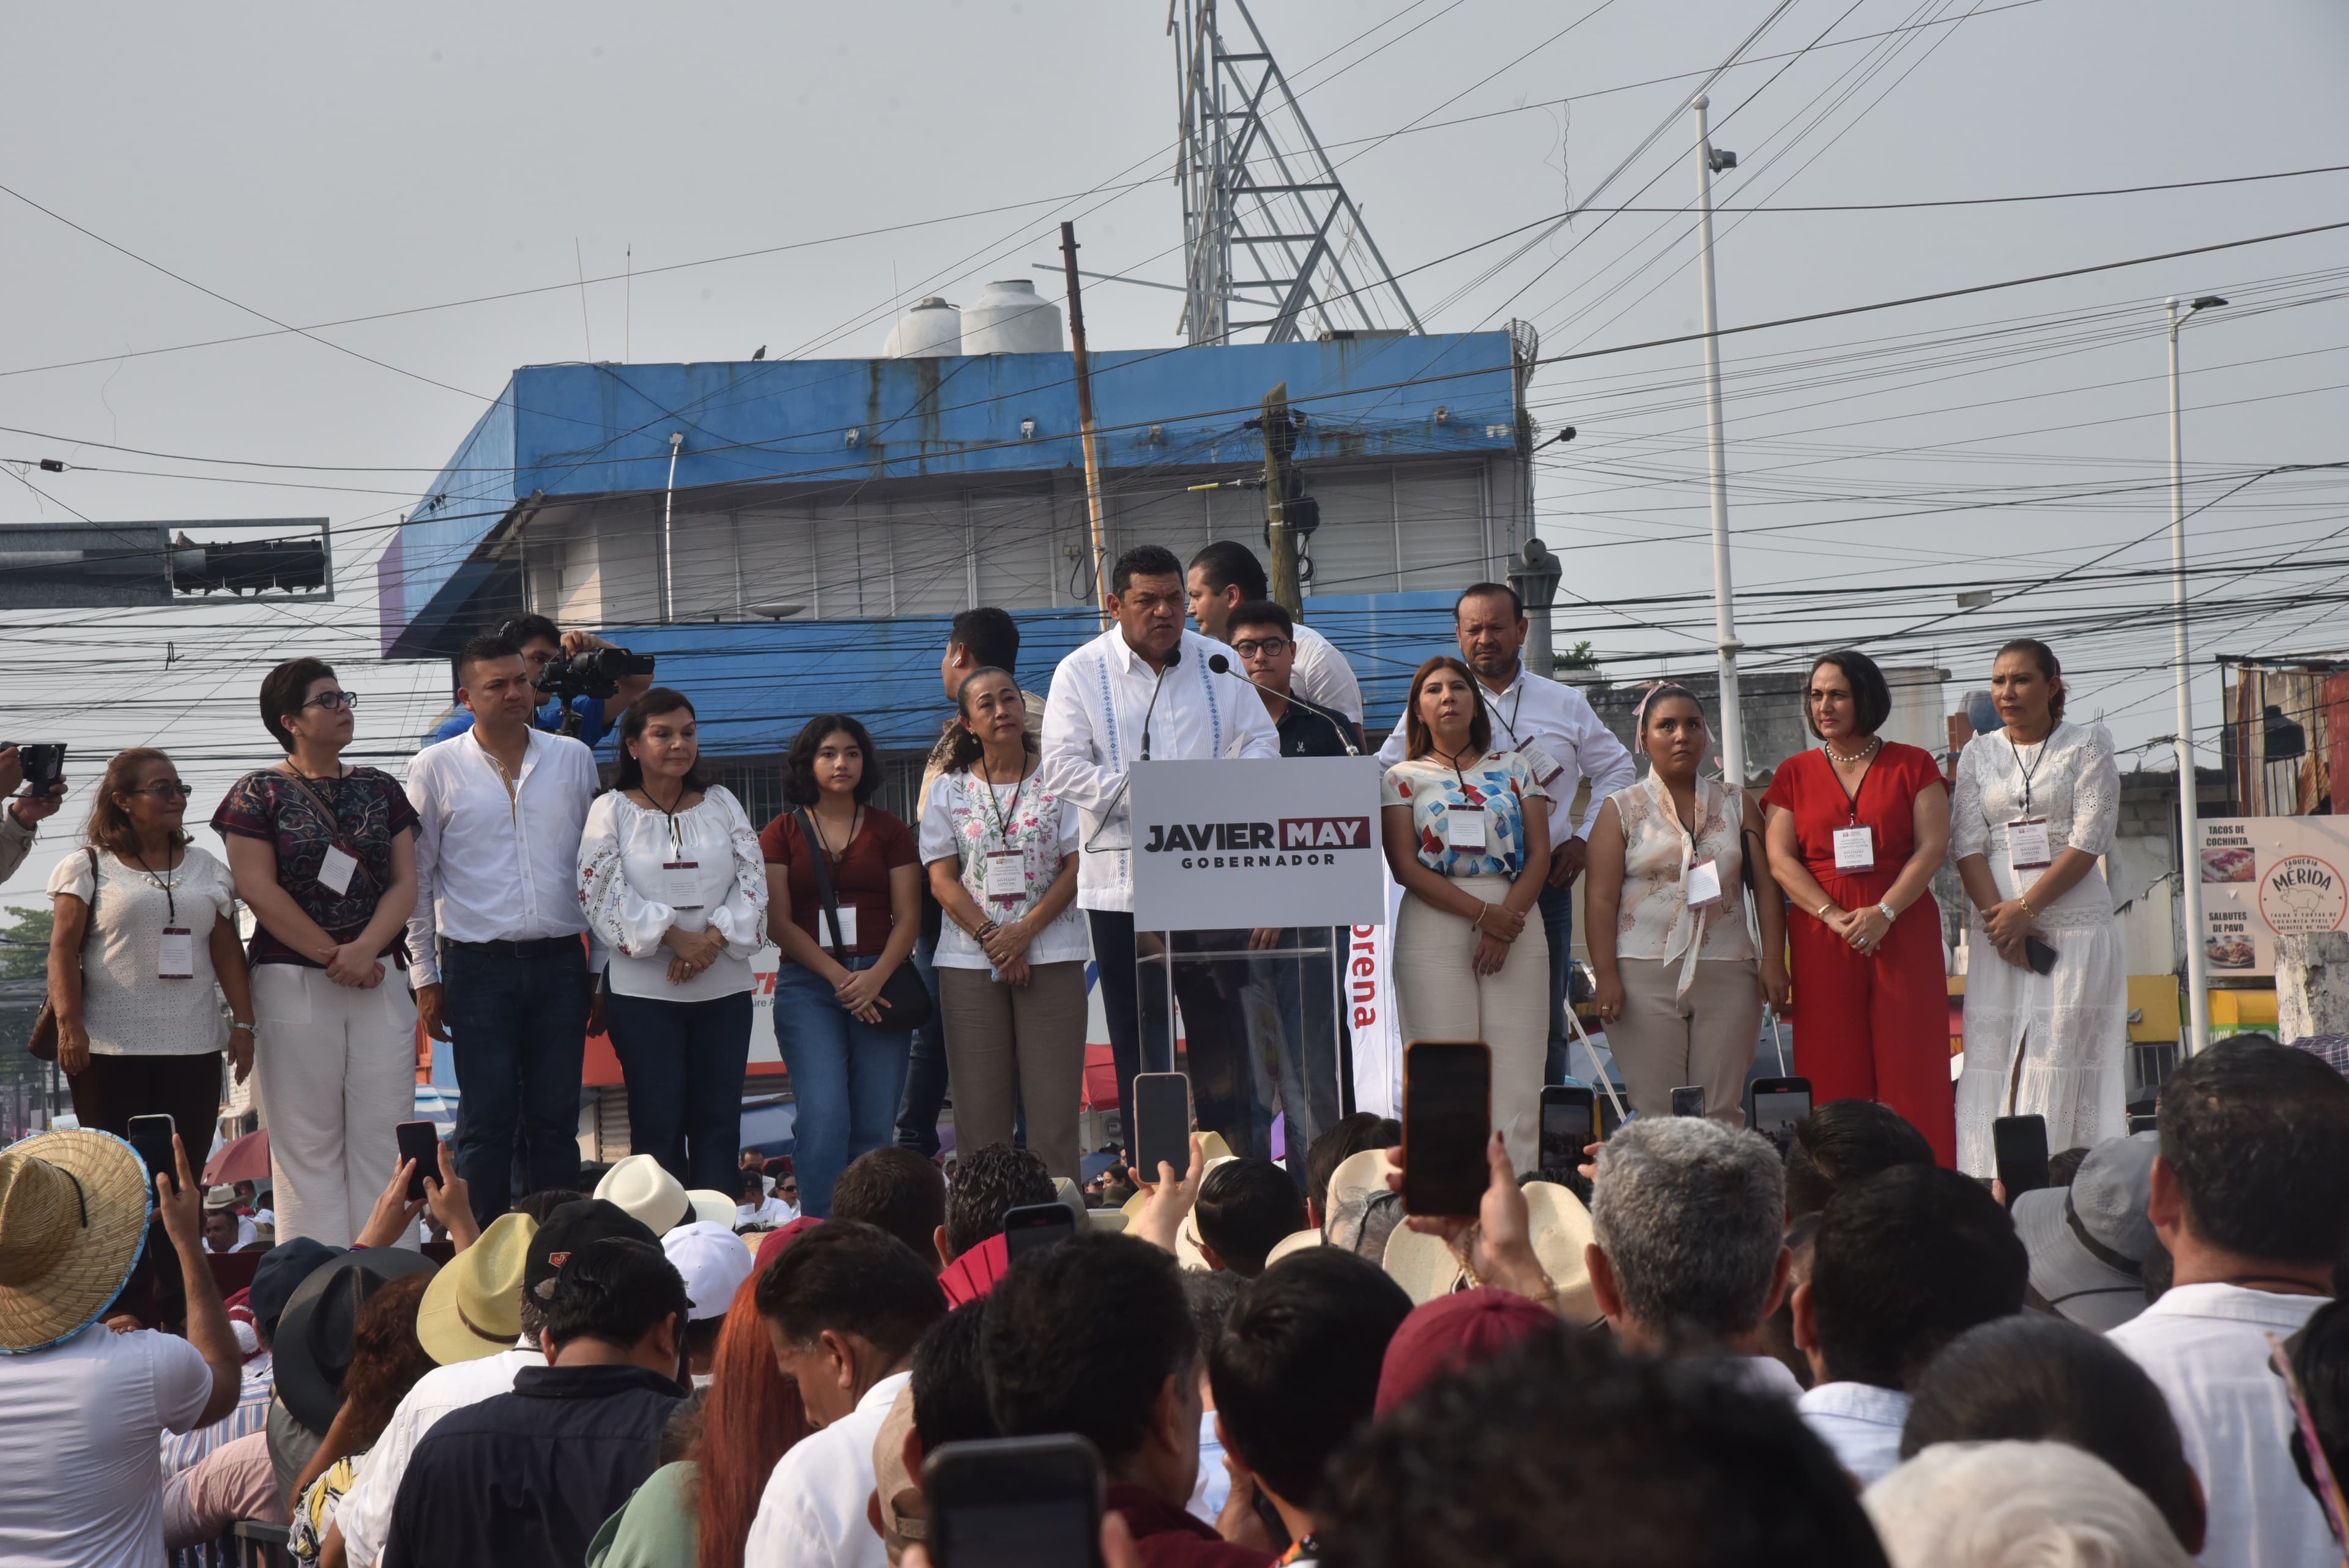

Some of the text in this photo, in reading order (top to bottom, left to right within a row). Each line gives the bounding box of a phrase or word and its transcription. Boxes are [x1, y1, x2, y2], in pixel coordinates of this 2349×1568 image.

[2208, 825, 2245, 834] TACOS DE
[1144, 821, 1361, 852] JAVIER MAY
[2206, 837, 2249, 847] COCHINITA
[1181, 853, 1335, 869] GOBERNADOR
[2272, 867, 2331, 891] MÉRIDA
[2209, 912, 2247, 921] SALBUTES
[2213, 924, 2244, 932] DE PAVO
[1352, 925, 1376, 1030] orena
[753, 998, 766, 1008] ire
